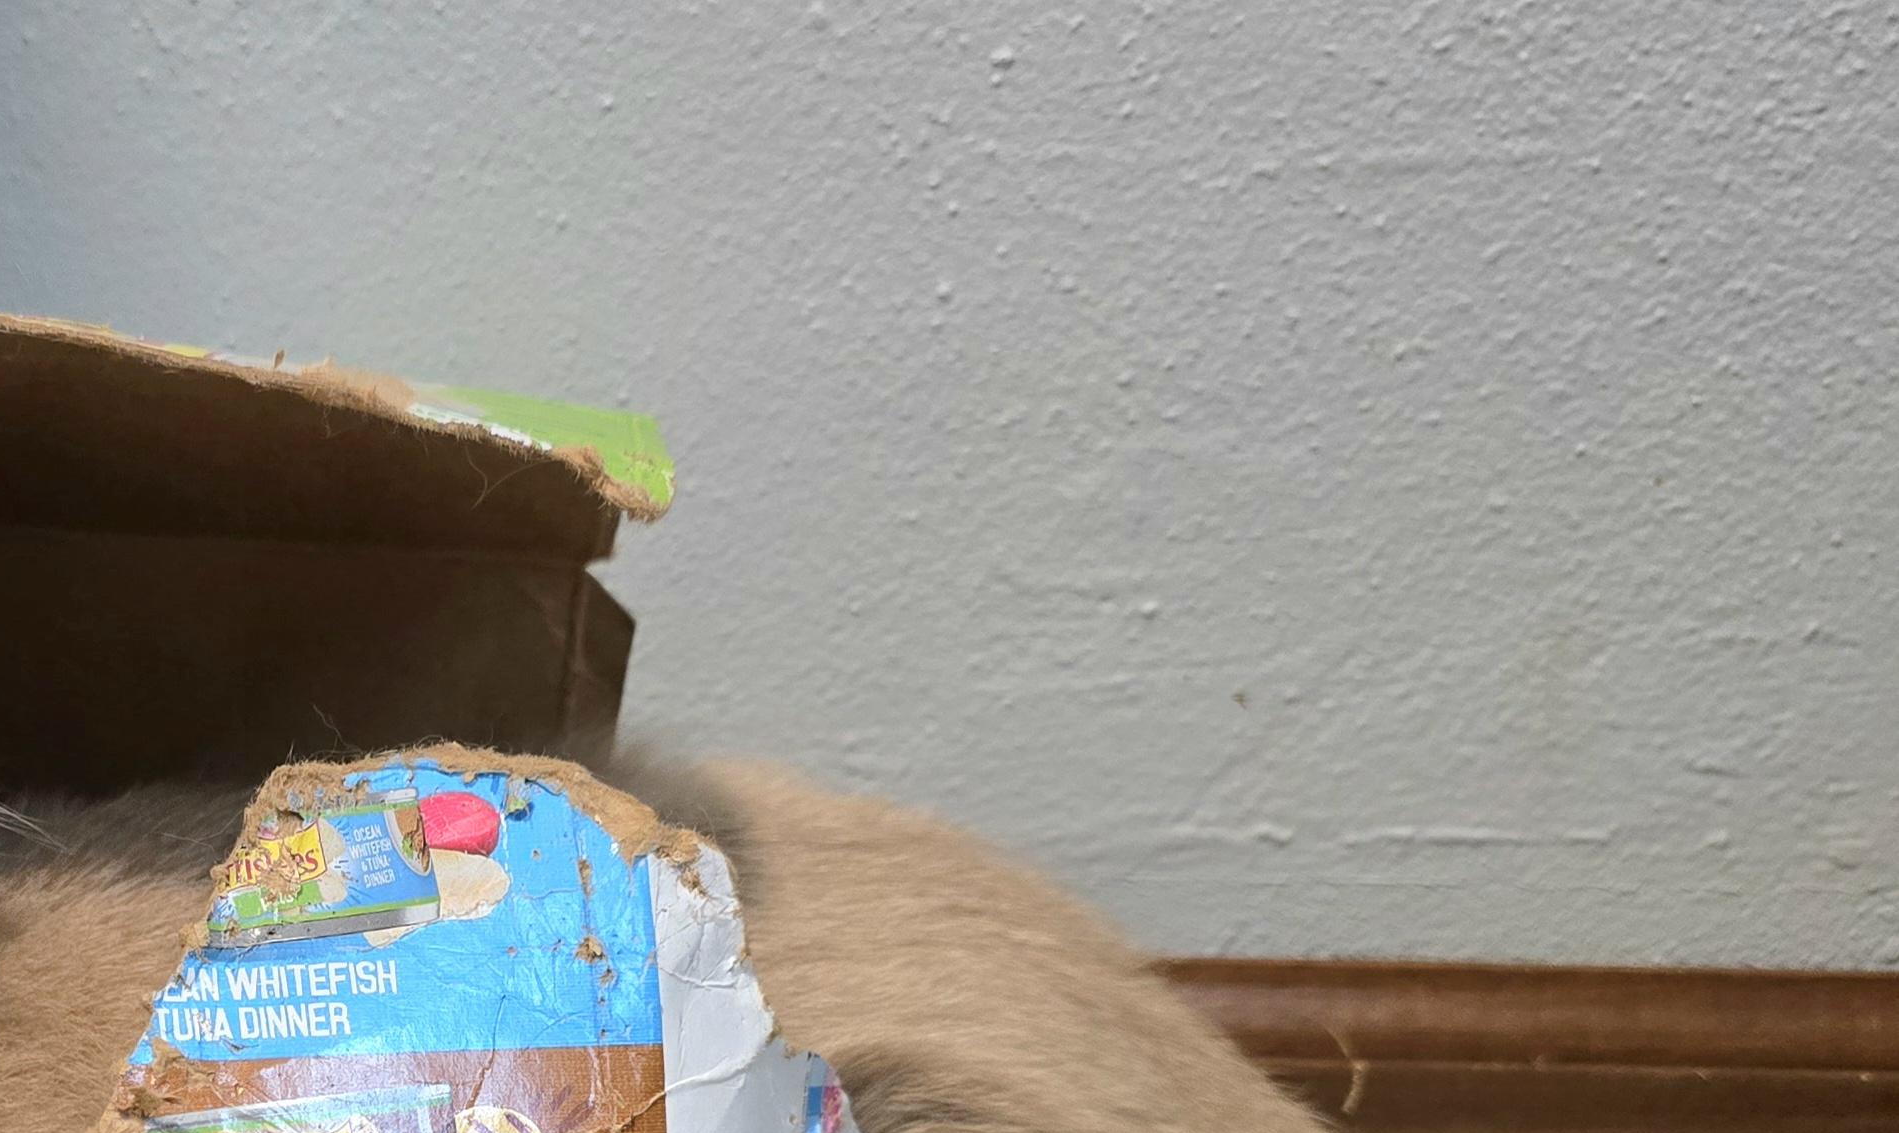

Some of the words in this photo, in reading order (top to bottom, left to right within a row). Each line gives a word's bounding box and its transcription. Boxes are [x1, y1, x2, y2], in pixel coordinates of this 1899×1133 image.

[225, 960, 398, 1000] WHITEFISH
[156, 1006, 233, 1042] TUNA
[237, 1003, 351, 1040] DINNER
